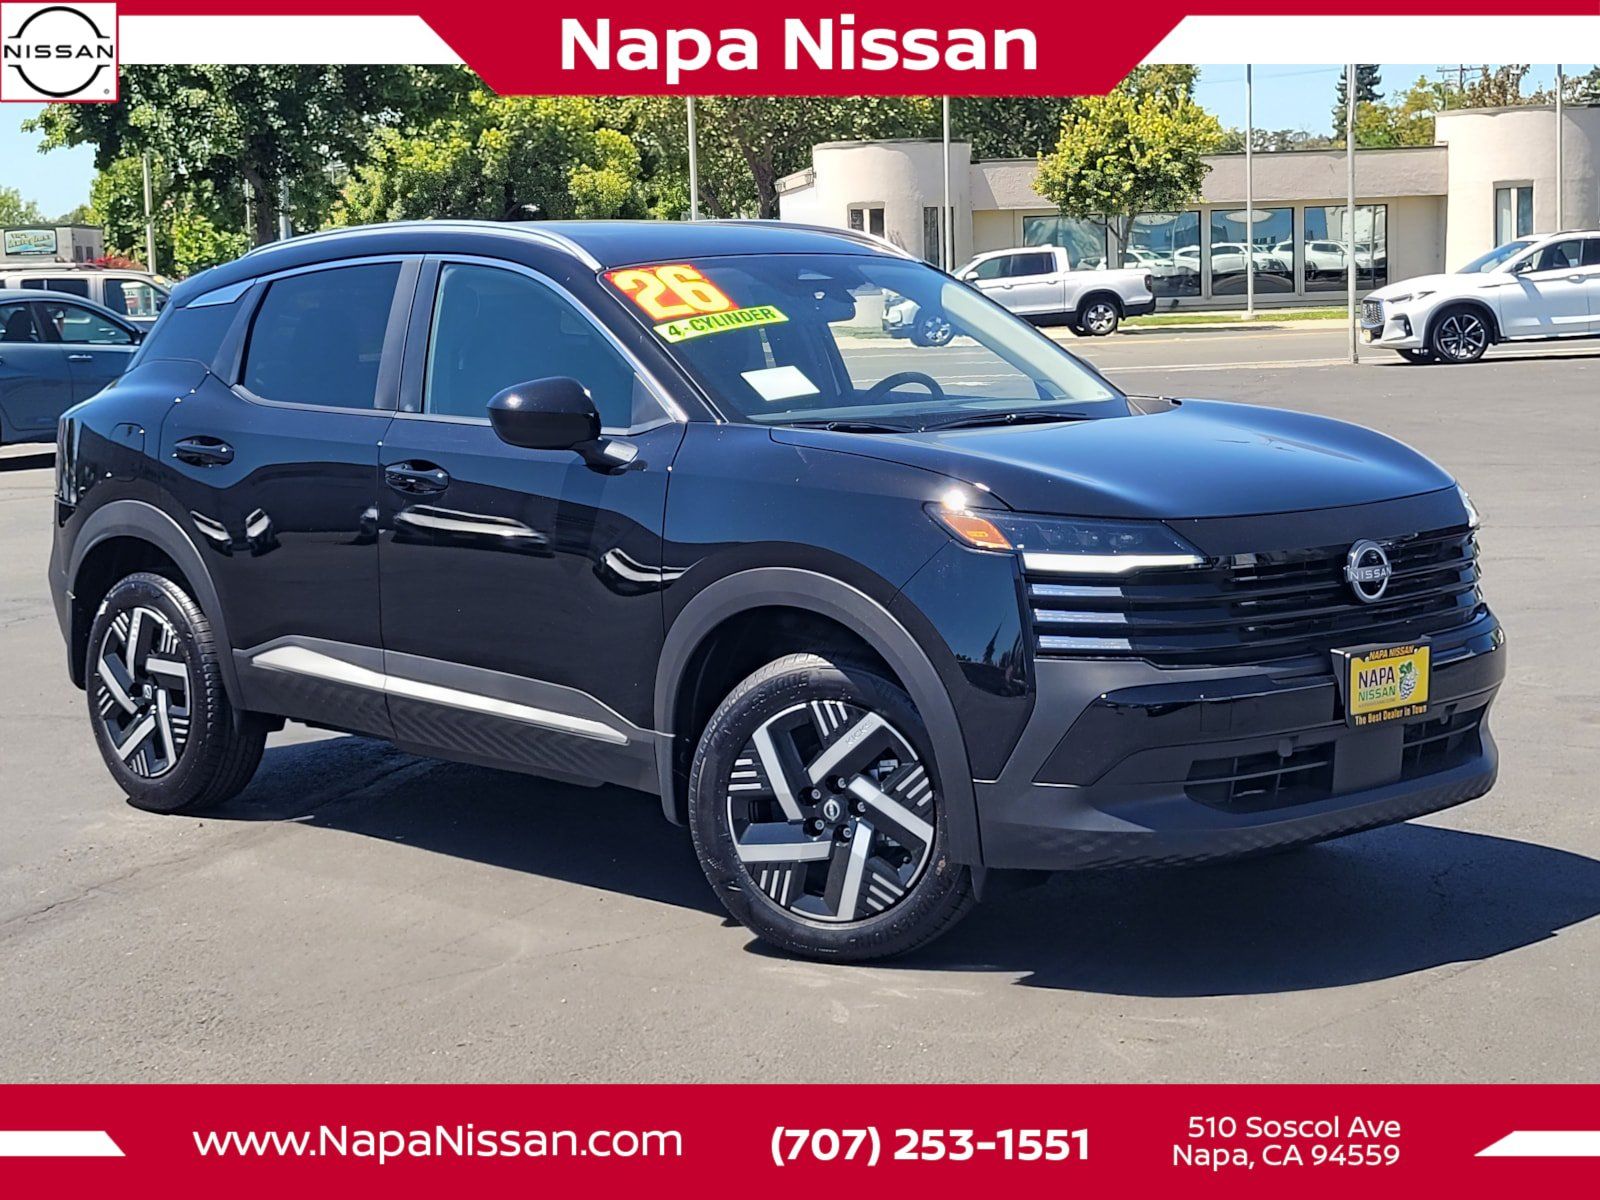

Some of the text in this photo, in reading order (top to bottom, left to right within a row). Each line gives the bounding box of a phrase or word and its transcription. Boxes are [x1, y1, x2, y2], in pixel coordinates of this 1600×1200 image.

[613, 265, 731, 320] 26
[668, 307, 777, 337] 4-CYLINDER
[1349, 566, 1392, 581] NISSAN
[1369, 645, 1414, 660] NAPA NISSAN
[1358, 666, 1395, 689] NAPA
[1358, 685, 1396, 702] NISSAN
[1355, 715, 1367, 726] The
[1368, 712, 1382, 723] Best
[1383, 708, 1403, 720] Dealer
[1412, 704, 1427, 715] Town
[844, 719, 874, 747] KICKS
